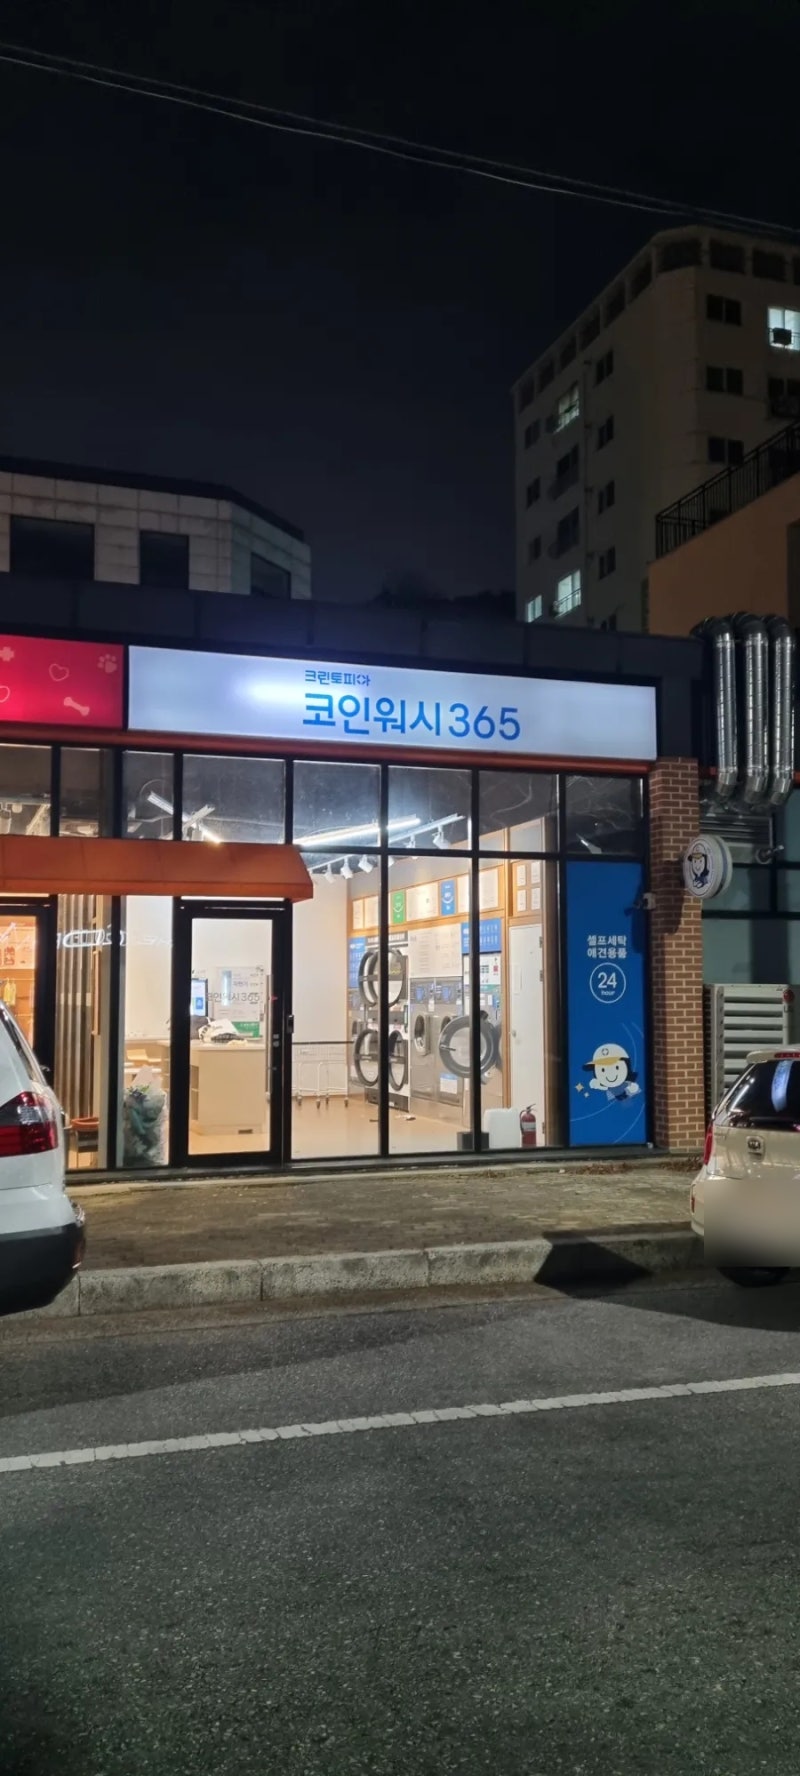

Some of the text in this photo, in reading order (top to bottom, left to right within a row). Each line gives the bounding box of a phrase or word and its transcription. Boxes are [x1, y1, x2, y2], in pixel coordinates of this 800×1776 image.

[304, 670, 371, 687] 크린토피아
[587, 935, 627, 946] 셀프세탁
[587, 947, 627, 959] 애견용품
[597, 971, 617, 989] 24
